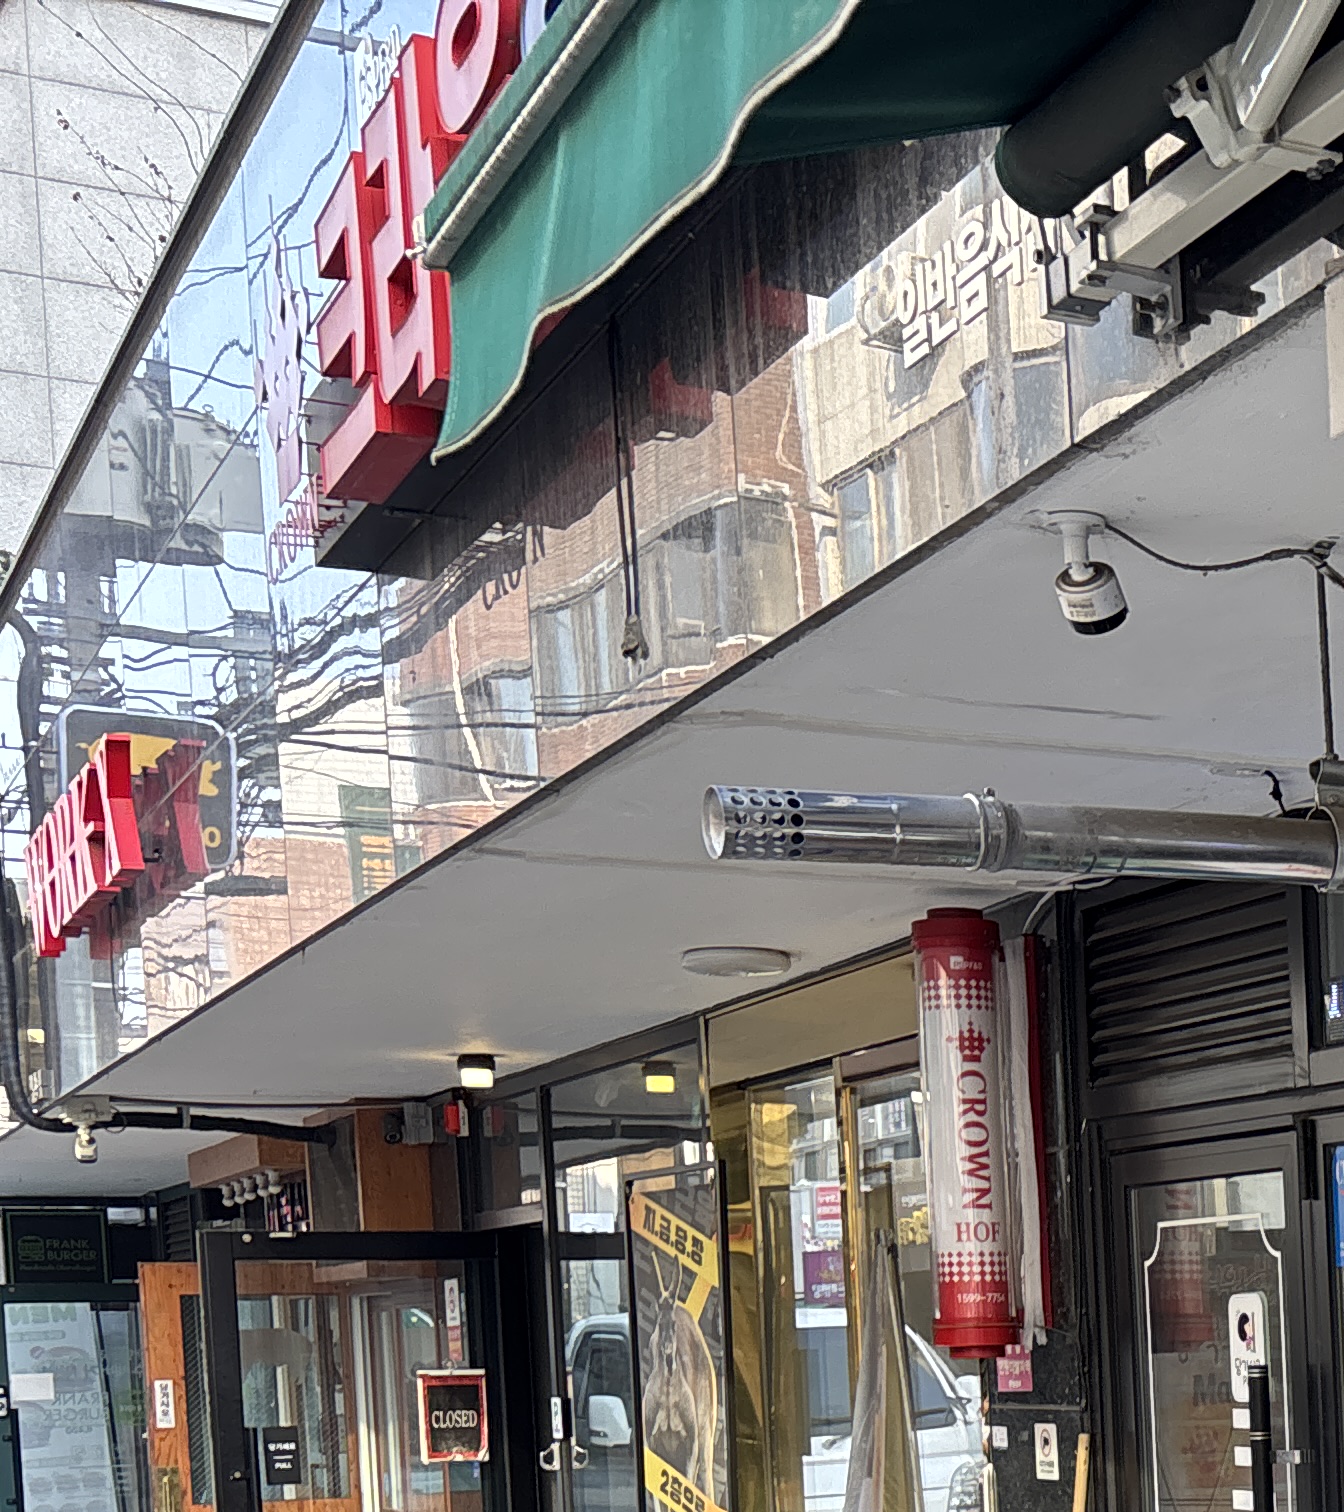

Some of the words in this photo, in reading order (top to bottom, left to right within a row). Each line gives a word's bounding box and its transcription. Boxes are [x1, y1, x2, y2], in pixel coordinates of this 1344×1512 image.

[956, 1069, 993, 1211] CROWN
[46, 1239, 90, 1249] FRANK
[47, 1250, 97, 1261] BURGER
[431, 1408, 478, 1429] CLOSED
